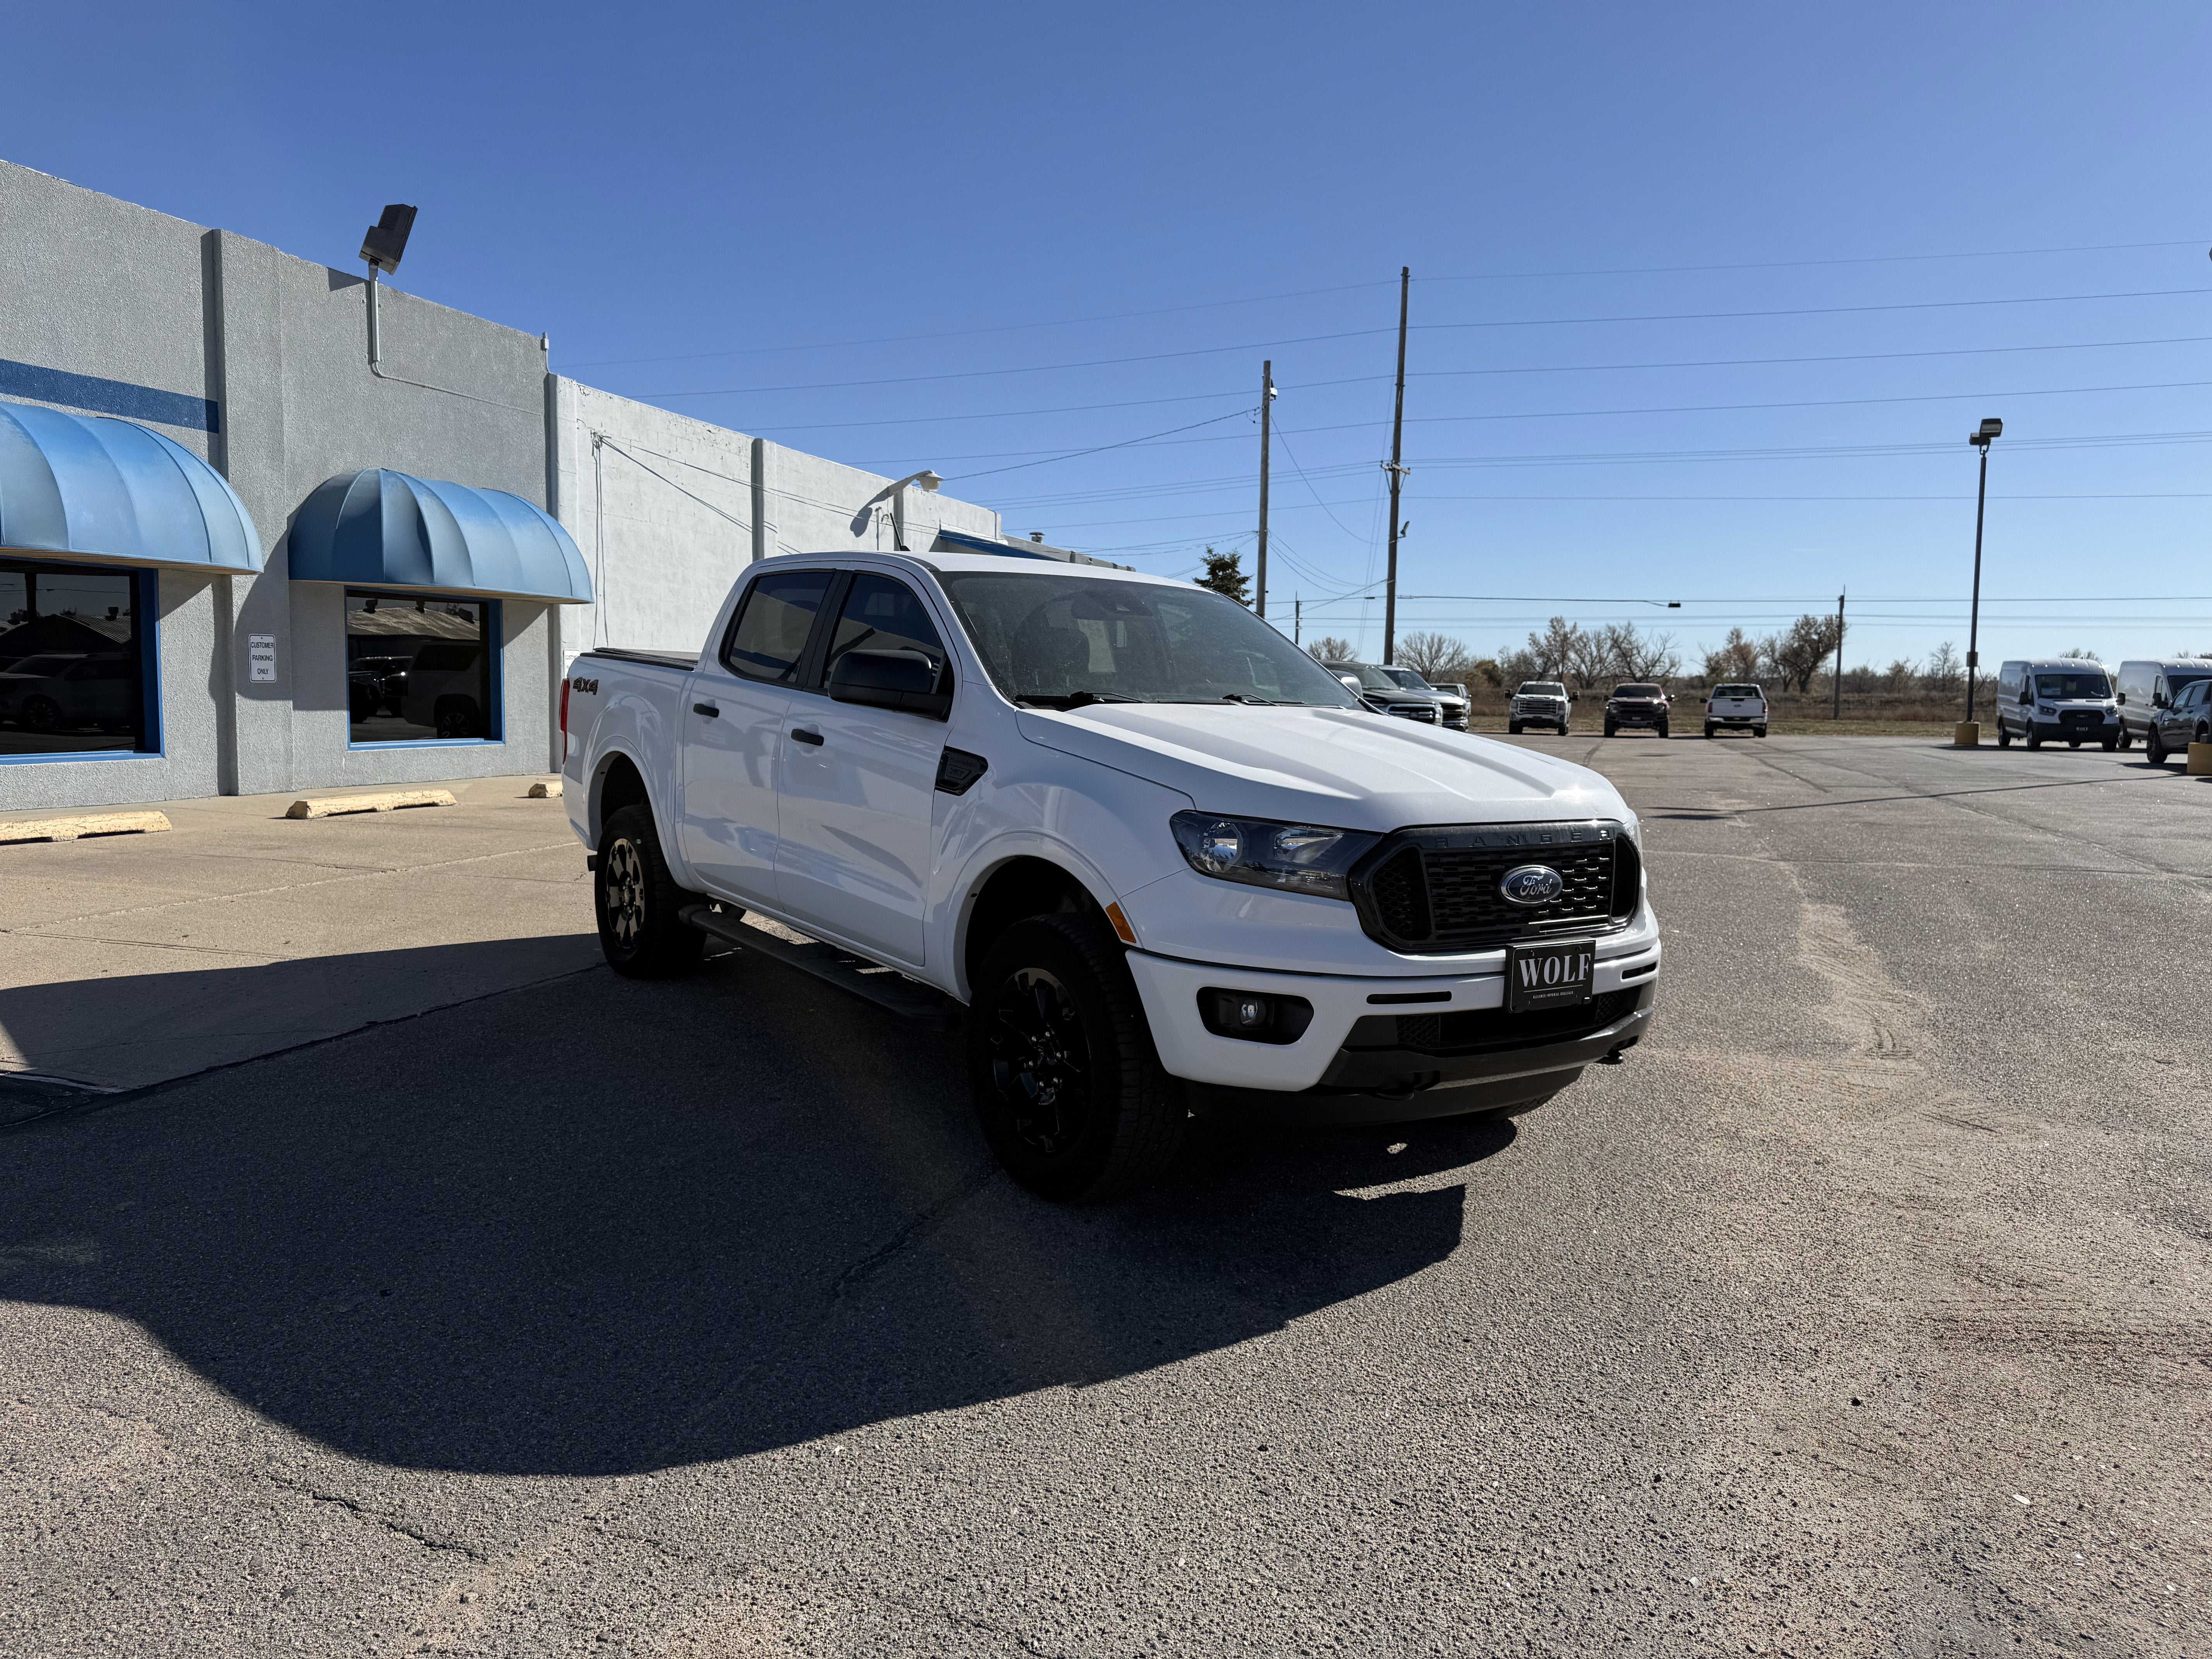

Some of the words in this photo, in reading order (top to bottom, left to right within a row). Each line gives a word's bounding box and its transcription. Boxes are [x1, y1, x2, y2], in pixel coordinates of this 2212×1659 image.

[1434, 830, 1611, 848] RANGER
[1520, 874, 1553, 896] Ford
[1518, 953, 1591, 987] WOLF
